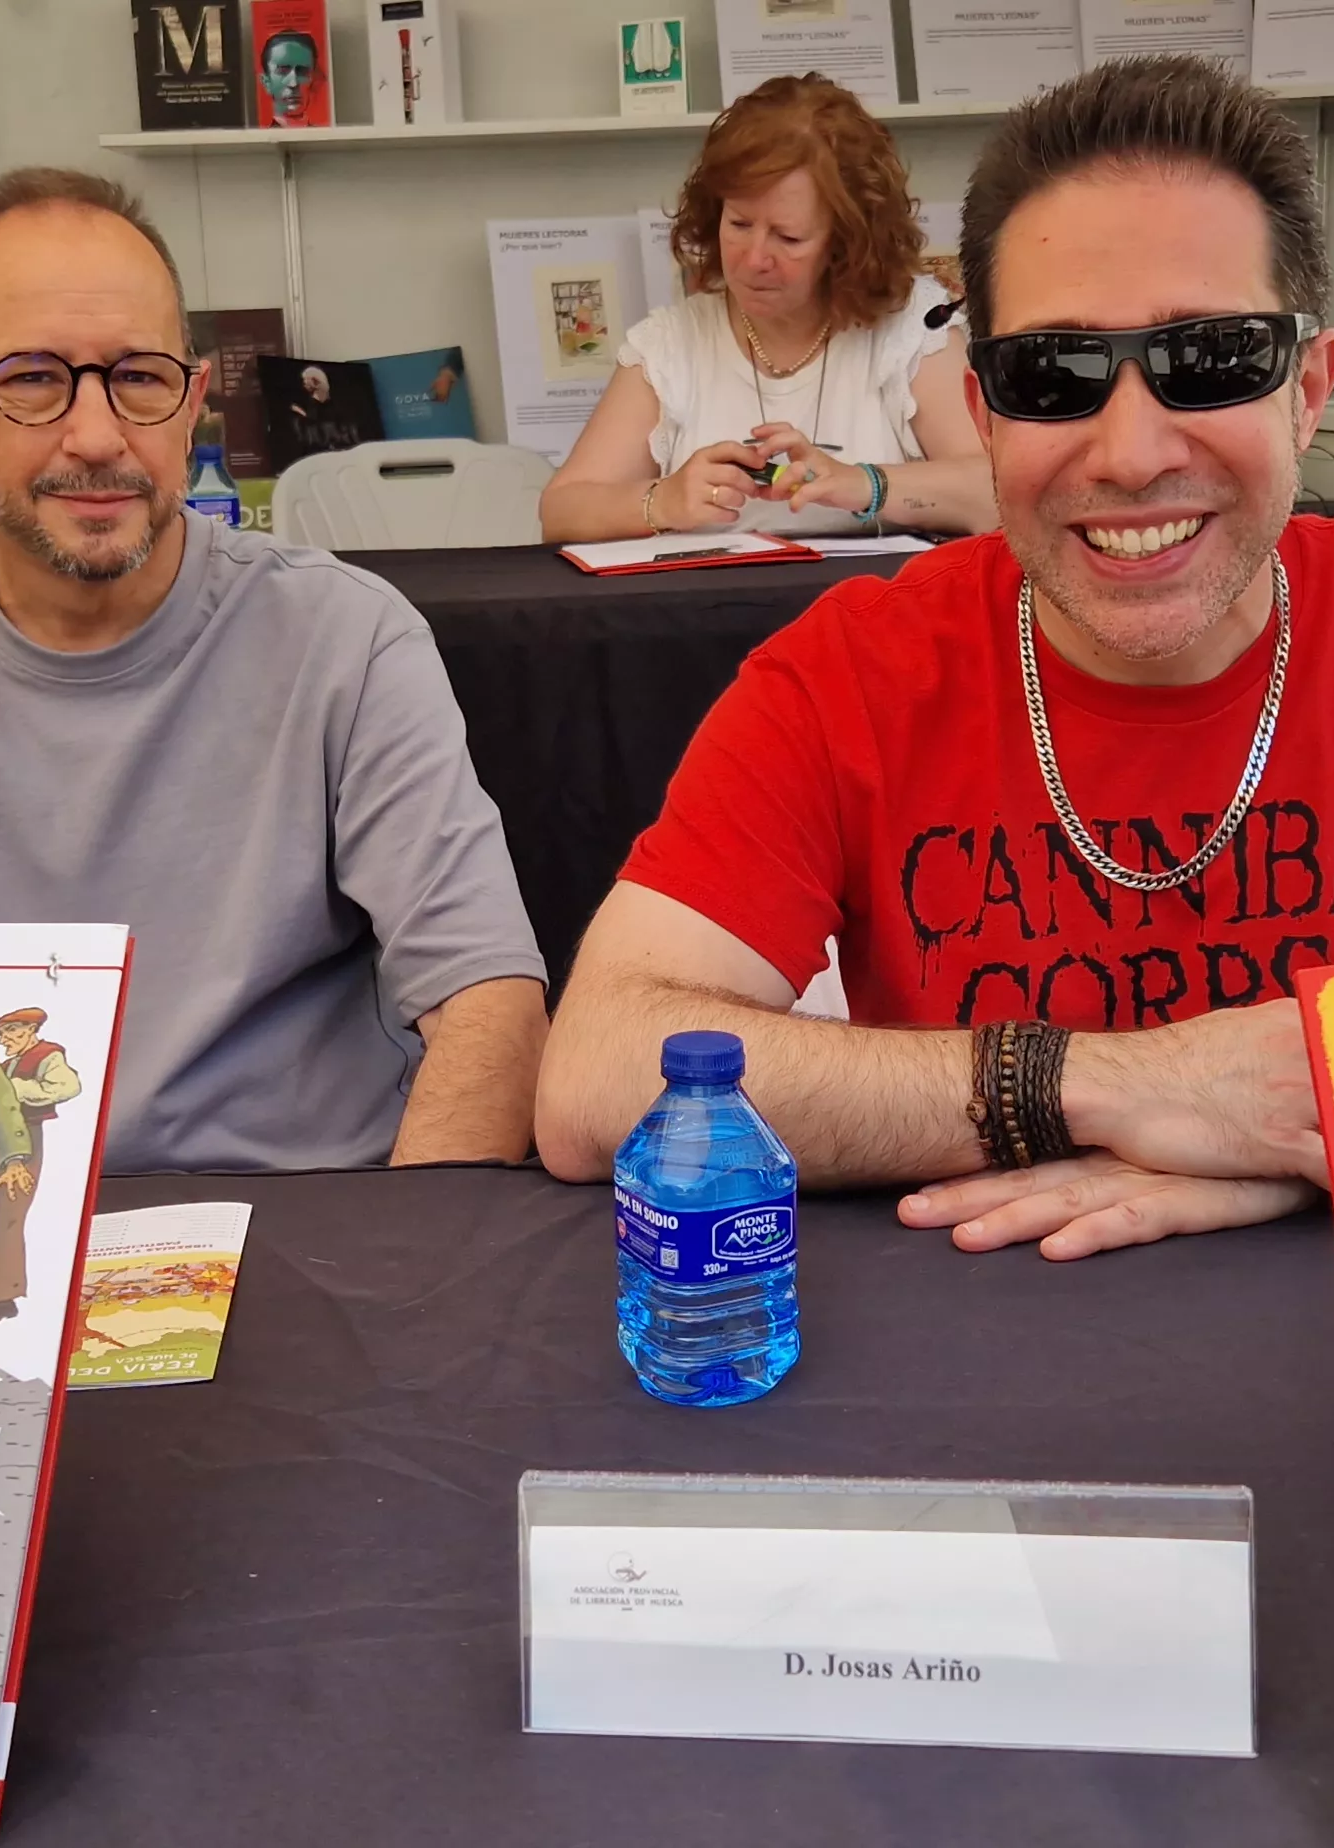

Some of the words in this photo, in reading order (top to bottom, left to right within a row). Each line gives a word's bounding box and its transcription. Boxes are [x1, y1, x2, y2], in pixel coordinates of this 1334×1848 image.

[150, 5, 229, 76] M
[499, 231, 540, 240] MUJERES
[542, 229, 588, 239] LECTORAS
[632, 1199, 643, 1216] EN
[643, 1206, 679, 1230] SODIO
[734, 1212, 778, 1230] MONTE
[740, 1223, 778, 1239] PINOS
[116, 1353, 174, 1364] HUESCA
[179, 1352, 199, 1360] DE
[123, 1359, 196, 1374] FERIA
[574, 1585, 625, 1595] ASOCIACIÓN
[629, 1586, 681, 1596] PROVINCIAL
[570, 1596, 581, 1605] DE
[635, 1598, 645, 1606] DE
[650, 1597, 684, 1607] HUESCA
[784, 1651, 813, 1676] D.
[821, 1653, 893, 1681] Josas
[902, 1657, 981, 1684] Ariño
